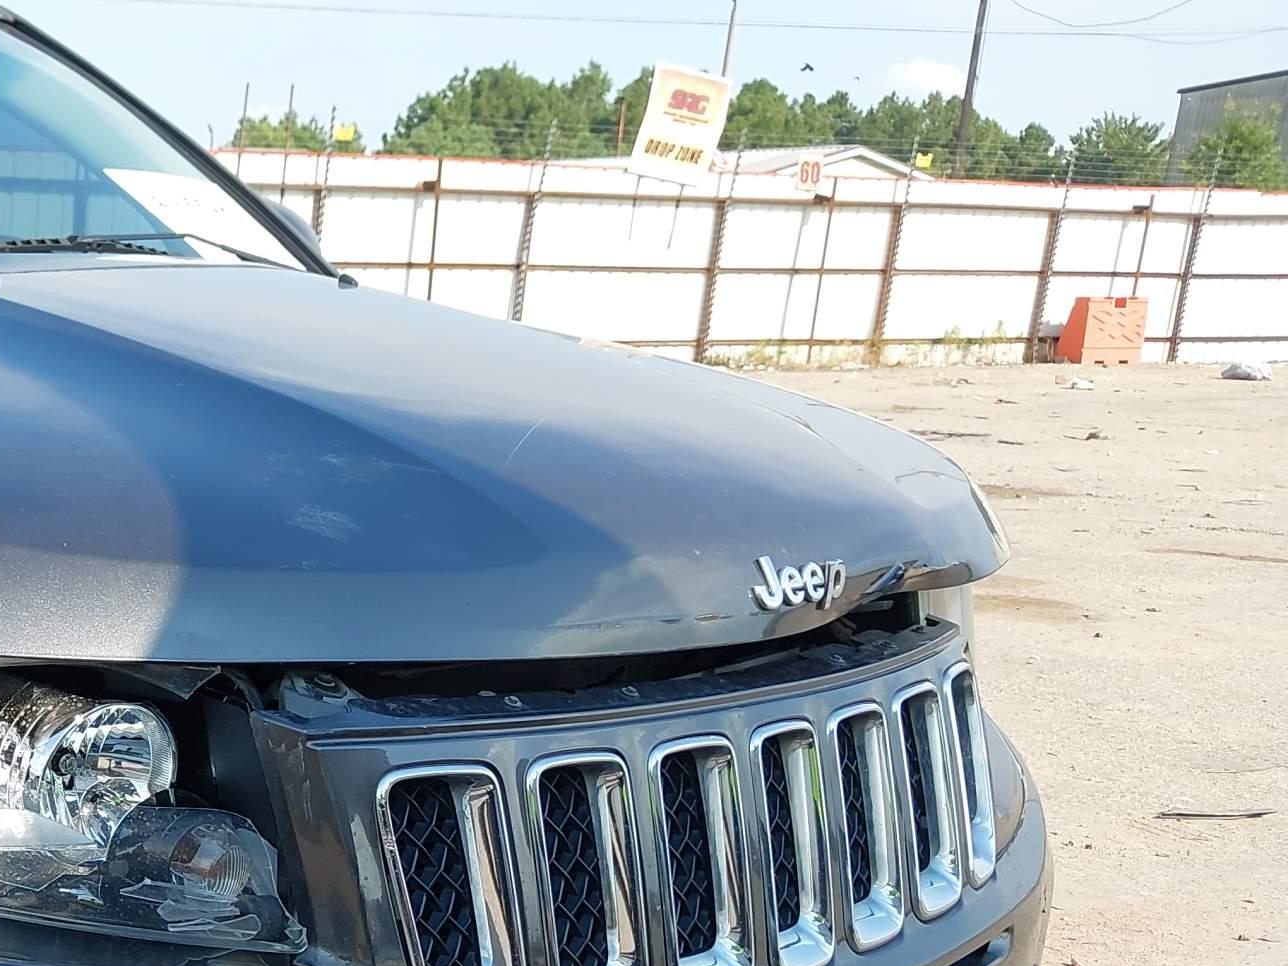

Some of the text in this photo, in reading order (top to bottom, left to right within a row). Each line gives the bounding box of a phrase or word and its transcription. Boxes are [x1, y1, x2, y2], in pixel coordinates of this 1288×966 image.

[644, 139, 704, 165] DROP ZONE
[800, 160, 821, 184] 60
[748, 555, 847, 611] Jeep
